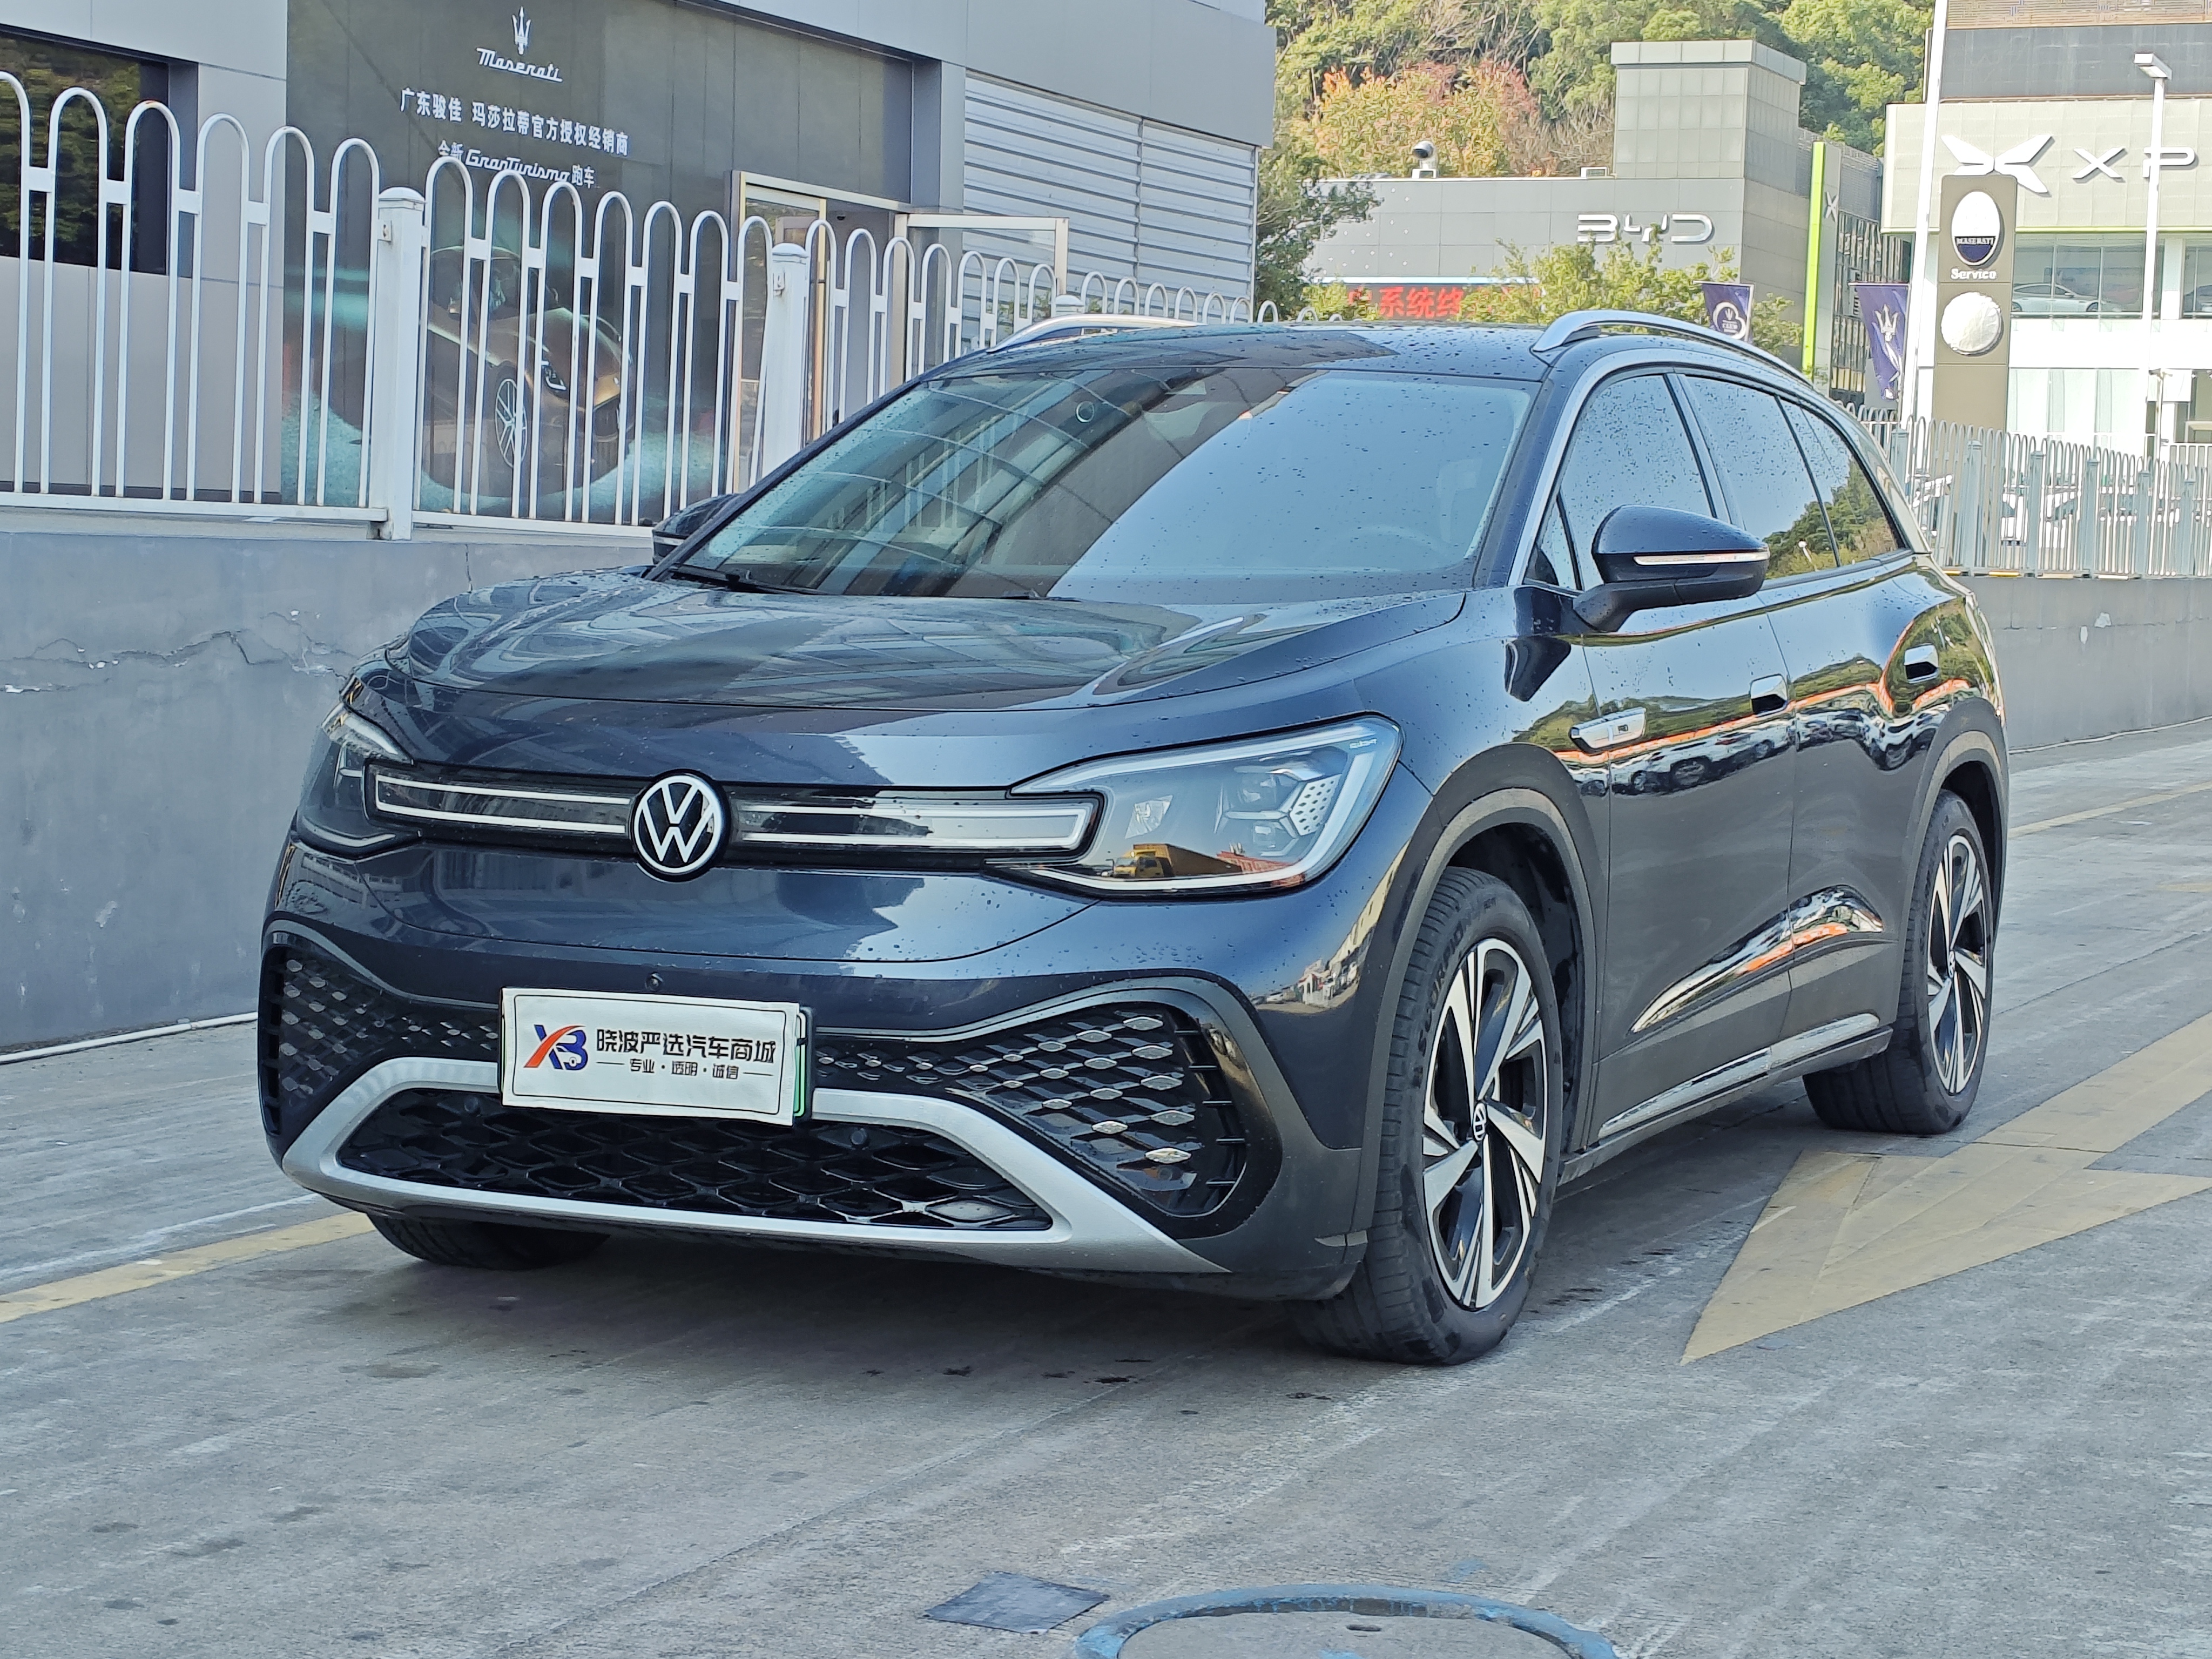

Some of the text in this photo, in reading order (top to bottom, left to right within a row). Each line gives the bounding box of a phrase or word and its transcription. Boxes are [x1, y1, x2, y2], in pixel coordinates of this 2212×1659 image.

[476, 48, 563, 82] Maserati
[401, 88, 630, 157] 广东骏佳 玛莎拉蒂官方授权经销商
[465, 148, 570, 182] GranTurismo
[571, 164, 596, 189] 跑车
[1576, 213, 1715, 244] BYD
[1951, 268, 1997, 279] Service
[596, 1028, 777, 1063] 晓波严选汽车商城
